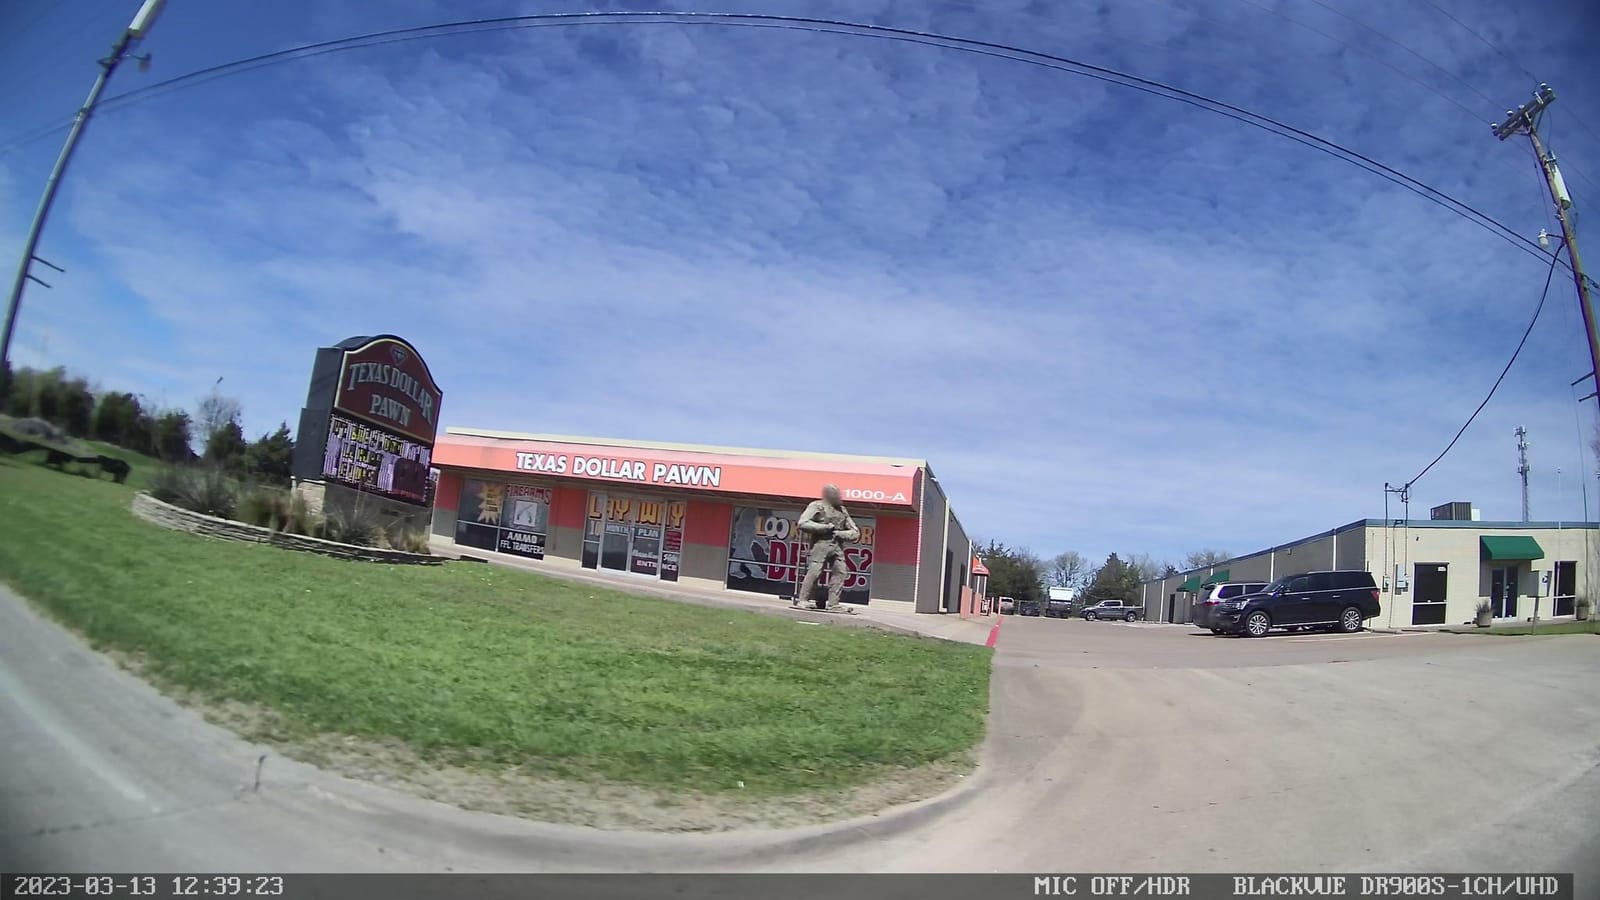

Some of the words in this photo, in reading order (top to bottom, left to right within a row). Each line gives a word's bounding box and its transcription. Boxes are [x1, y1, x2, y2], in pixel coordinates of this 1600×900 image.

[347, 362, 390, 390] TEXAS
[389, 367, 433, 424] DOLLAR
[369, 393, 411, 427] PAWN
[516, 452, 567, 473] TEXAS
[573, 457, 646, 481] DOLLAR
[653, 463, 721, 487] PAWN
[505, 483, 552, 506] FIREARMS
[844, 489, 907, 502] 1000-A
[507, 531, 538, 544] AMMO
[638, 528, 659, 538] PLAN
[500, 539, 511, 549] FFL
[512, 541, 545, 555] TRANSFERS
[636, 559, 678, 571] ENTRNCE
[766, 539, 873, 589] DES?
